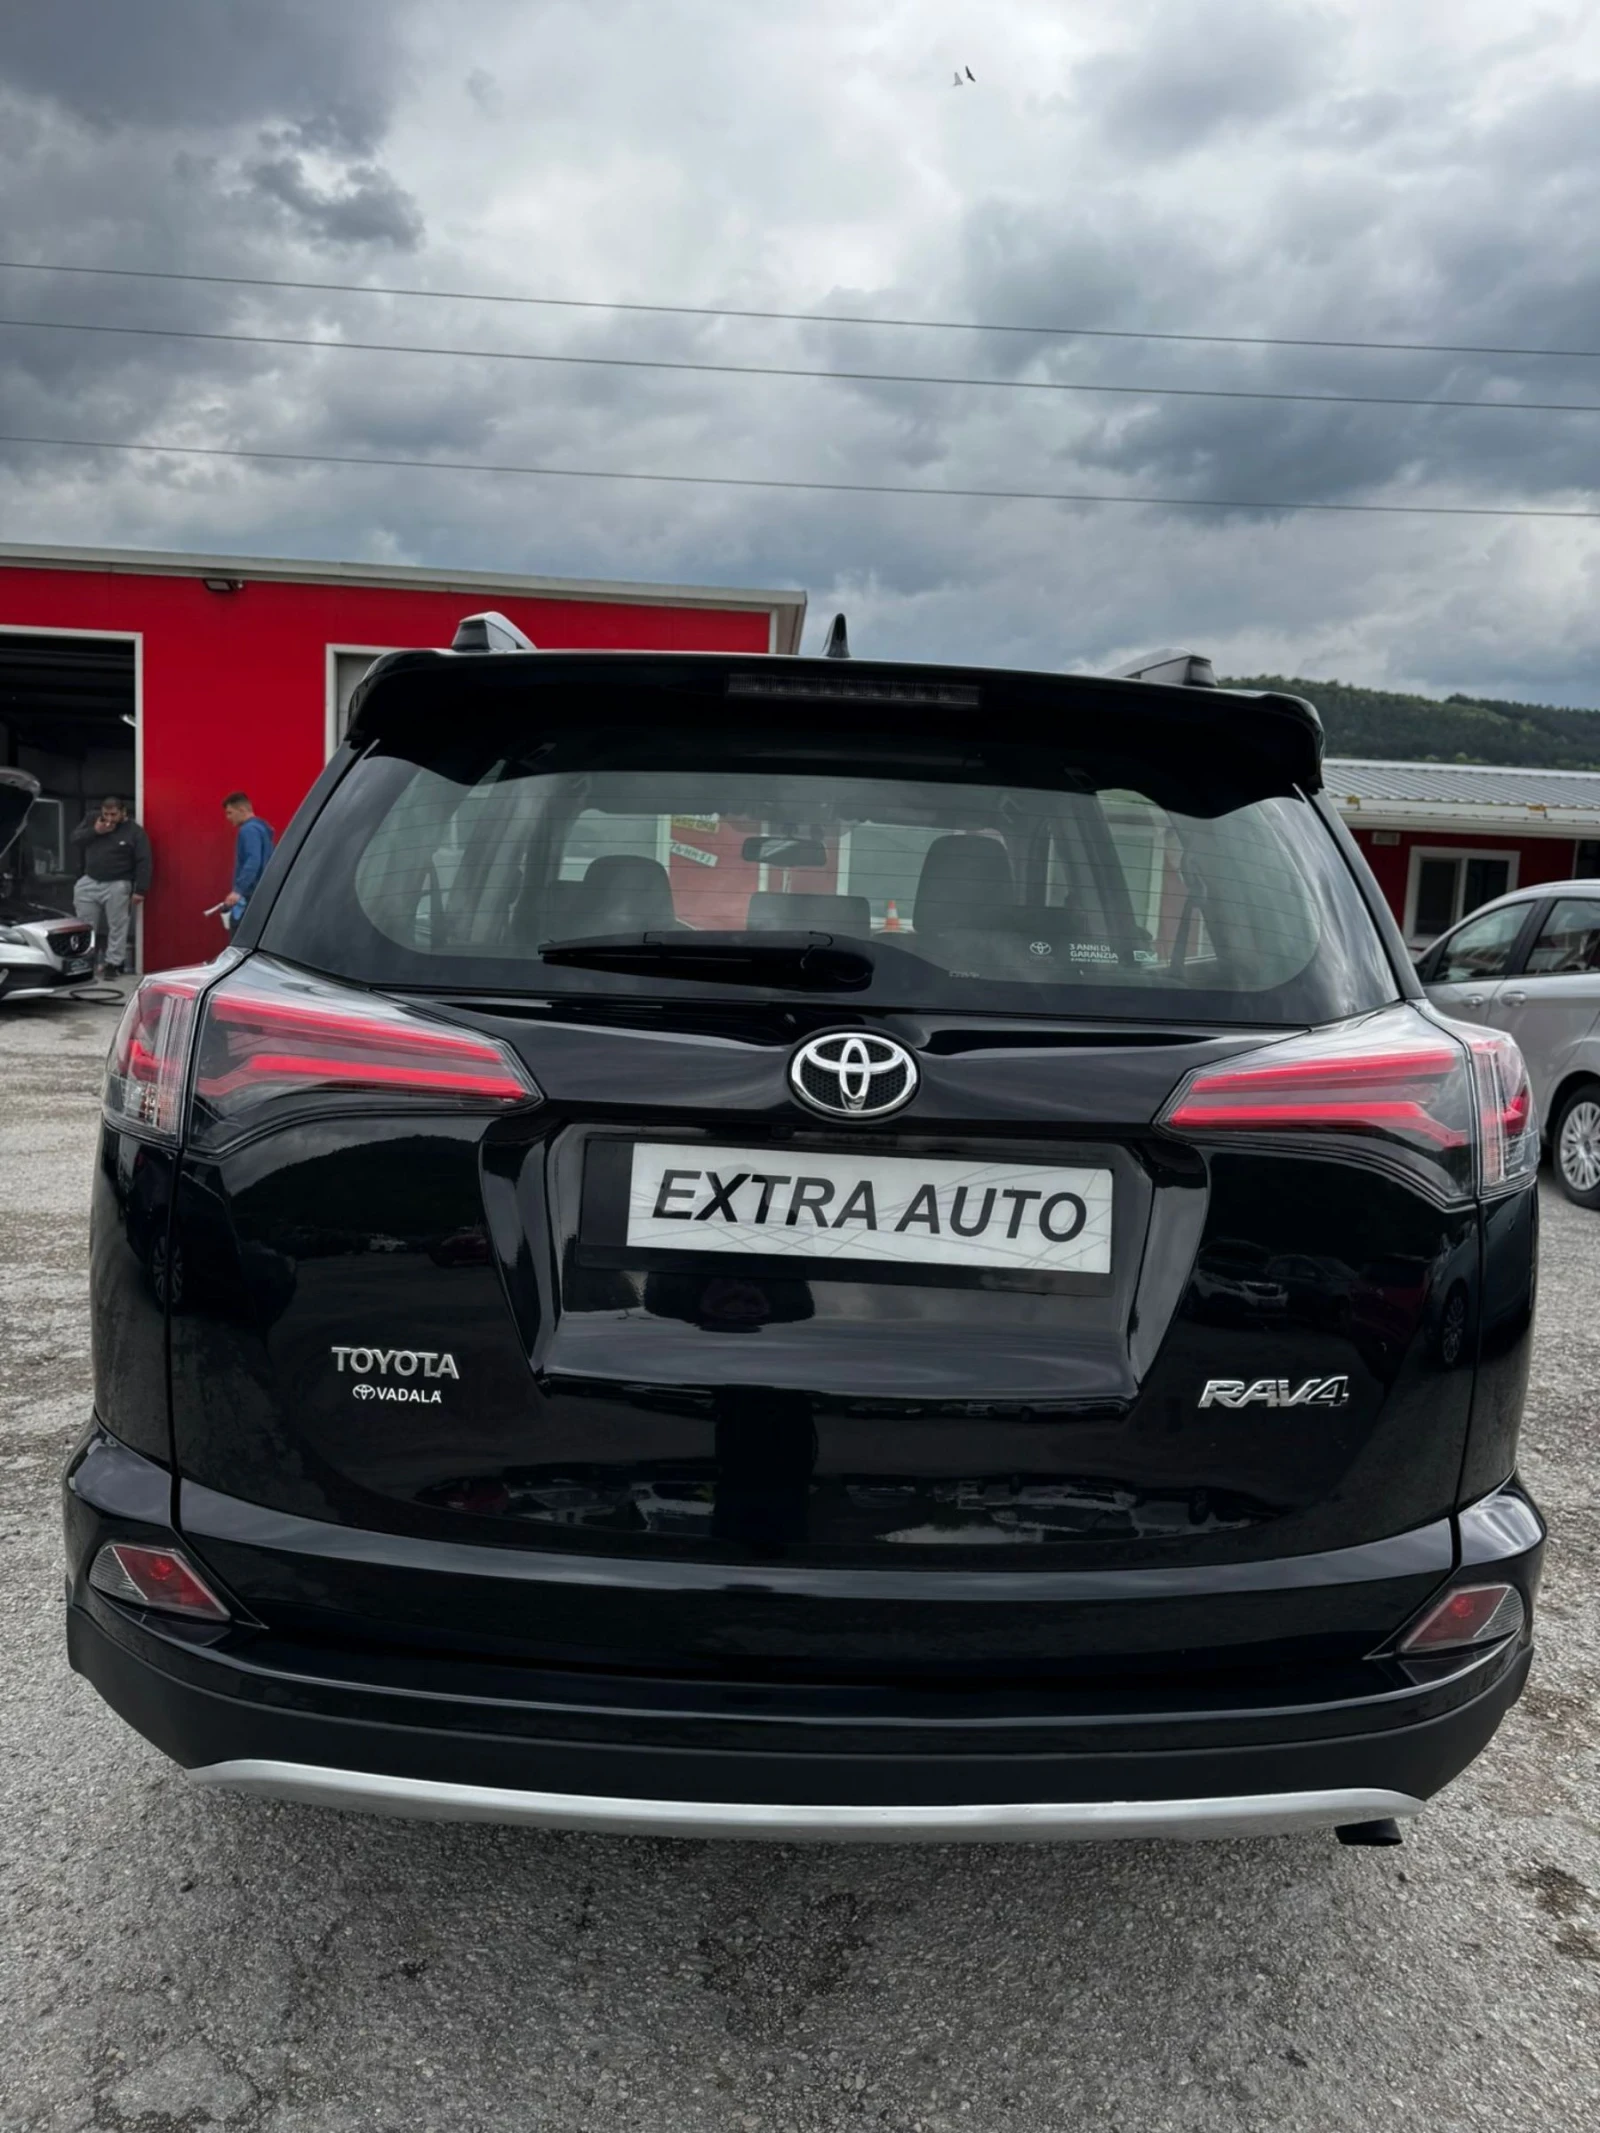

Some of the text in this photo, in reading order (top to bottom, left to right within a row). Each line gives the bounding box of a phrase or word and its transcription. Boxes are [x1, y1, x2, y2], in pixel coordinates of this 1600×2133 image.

[1070, 951, 1119, 960] GARANZIA
[1077, 943, 1099, 951] ANNI
[652, 1169, 1087, 1242] EXTRA AUTO
[331, 1346, 460, 1379] TOYOTA
[1198, 1375, 1349, 1407] RAV4
